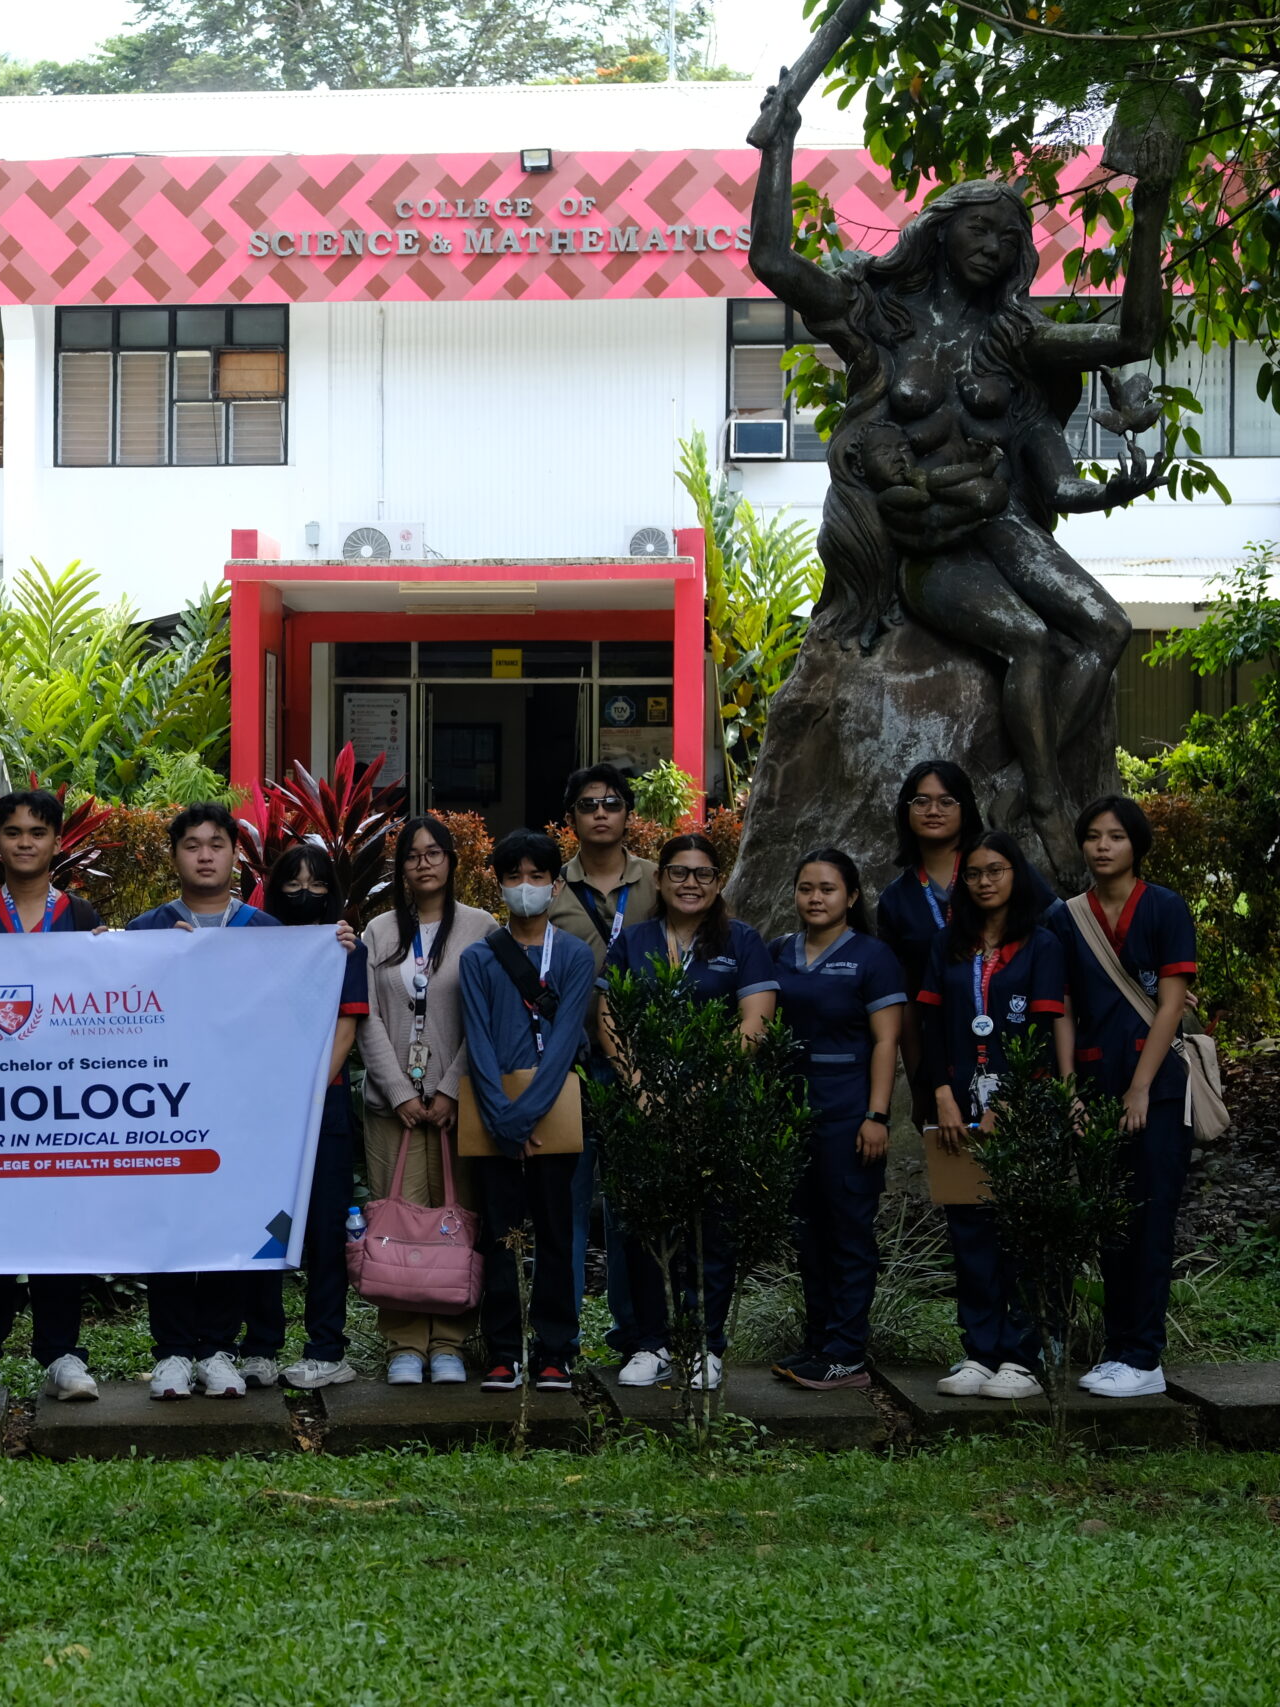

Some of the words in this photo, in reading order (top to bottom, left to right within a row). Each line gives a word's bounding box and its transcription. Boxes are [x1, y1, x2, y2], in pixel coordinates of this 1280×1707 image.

[394, 197, 534, 219] COLLEGE
[559, 196, 597, 217] OF
[247, 229, 421, 258] SCIENCE
[428, 231, 453, 255] &
[462, 224, 752, 255] MATHEMATICS
[400, 543, 411, 551] LG
[51, 984, 165, 1015] MAPÚA
[50, 1016, 107, 1027] MALAYAN
[109, 1014, 165, 1026] COLLEGES
[70, 1026, 144, 1037] MINDANAO
[57, 1056, 74, 1071] of
[79, 1055, 148, 1070] Science
[153, 1054, 169, 1069] in
[10, 1133, 31, 1148] IN
[34, 1131, 120, 1148] MEDICAL
[125, 1128, 211, 1145] BIOLOGY
[34, 1159, 52, 1171] OF
[55, 1158, 110, 1171] HEALTH
[113, 1156, 182, 1169] SCIENCES
